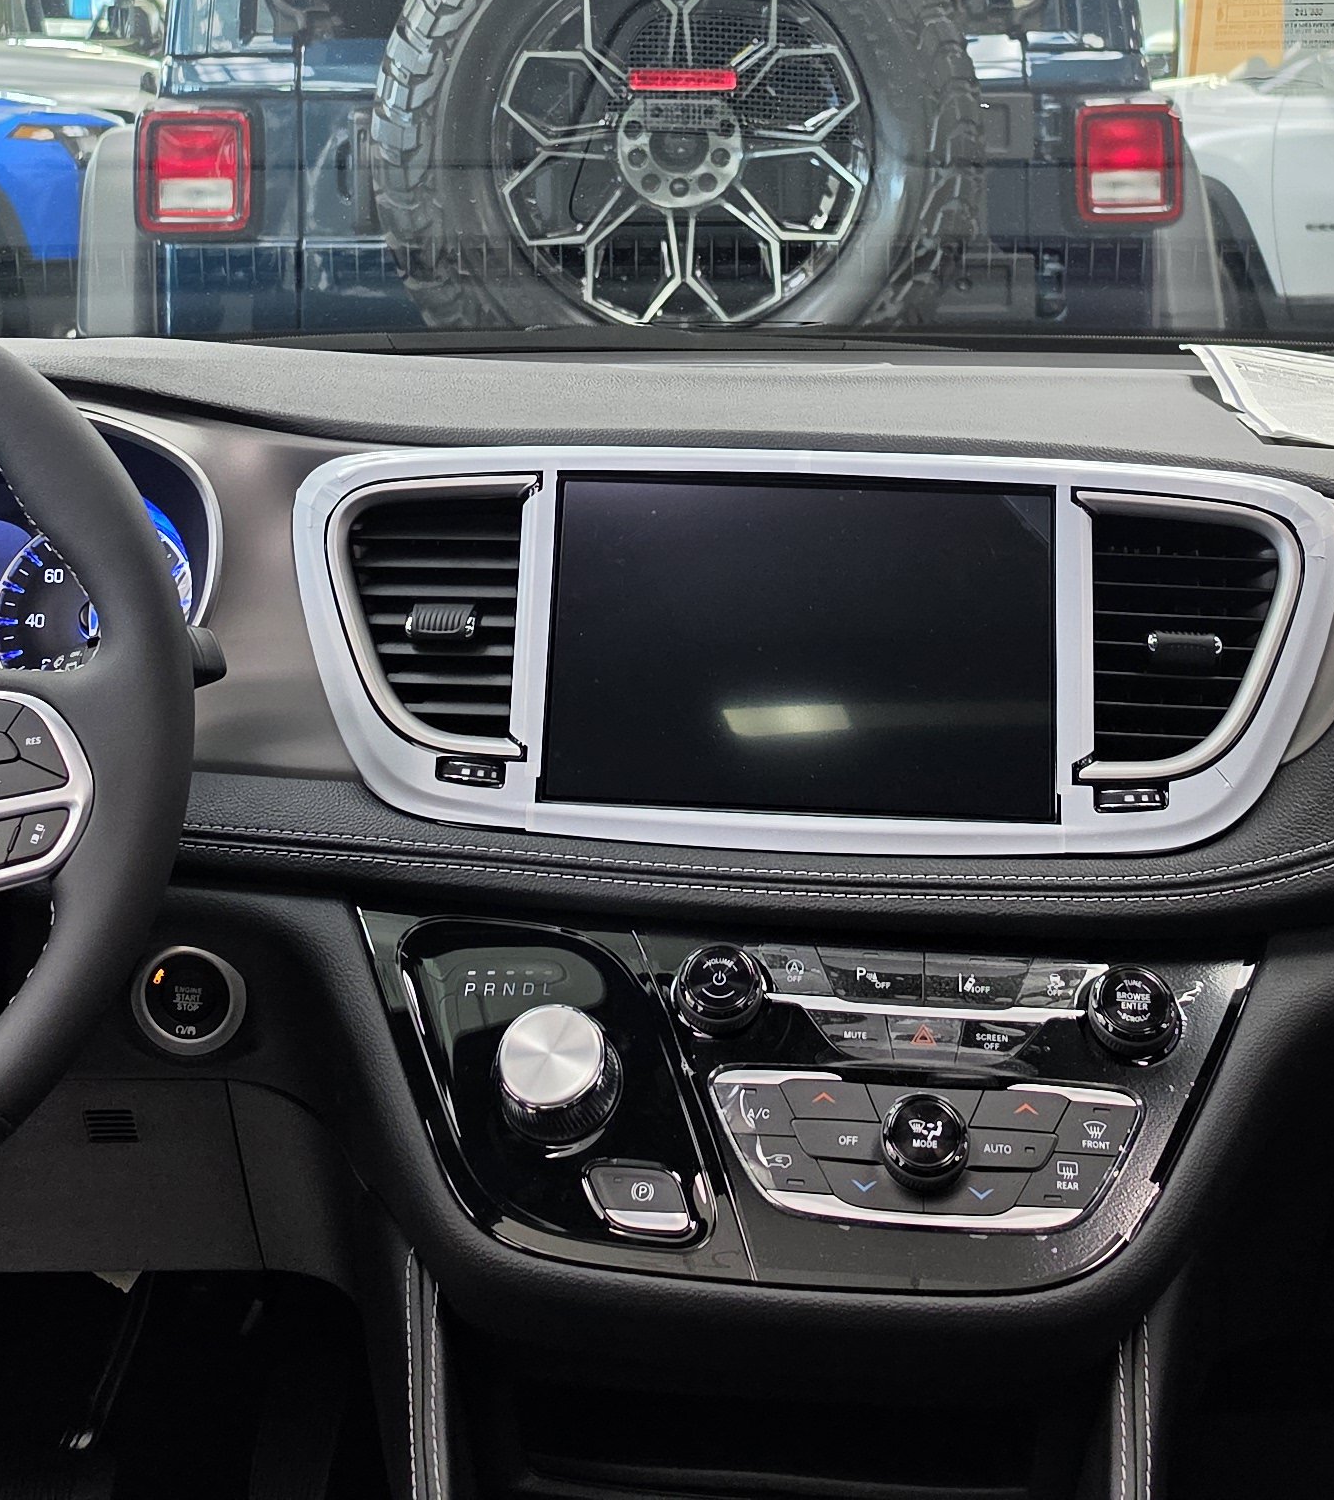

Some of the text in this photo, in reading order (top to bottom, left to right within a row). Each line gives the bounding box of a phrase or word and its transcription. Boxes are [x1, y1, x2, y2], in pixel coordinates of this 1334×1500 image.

[44, 568, 64, 584] 60
[24, 613, 45, 628] 40
[25, 736, 42, 746] RES
[706, 957, 735, 968] VOLUME
[786, 975, 803, 983] OFF
[1123, 978, 1143, 989] TUNE
[174, 985, 203, 995] ENGINE
[874, 981, 892, 989] OFF
[974, 985, 991, 994] OFF
[1046, 988, 1063, 997] OFF
[1116, 991, 1151, 1001] BROWSE
[175, 993, 201, 1003] START
[176, 1002, 200, 1012] STOP
[1120, 1001, 1149, 1012] ENTER
[1120, 1012, 1149, 1023] SCROLL
[843, 1030, 868, 1040] MUTE
[975, 1032, 1009, 1043] SCREEN
[983, 1042, 1000, 1051] OFF
[746, 1107, 770, 1120] A/C
[838, 1135, 859, 1146] OFF
[912, 1138, 938, 1149] MODE
[1081, 1139, 1111, 1150] FRONT
[983, 1143, 1012, 1155] AUTO
[1056, 1181, 1079, 1191] REAR
